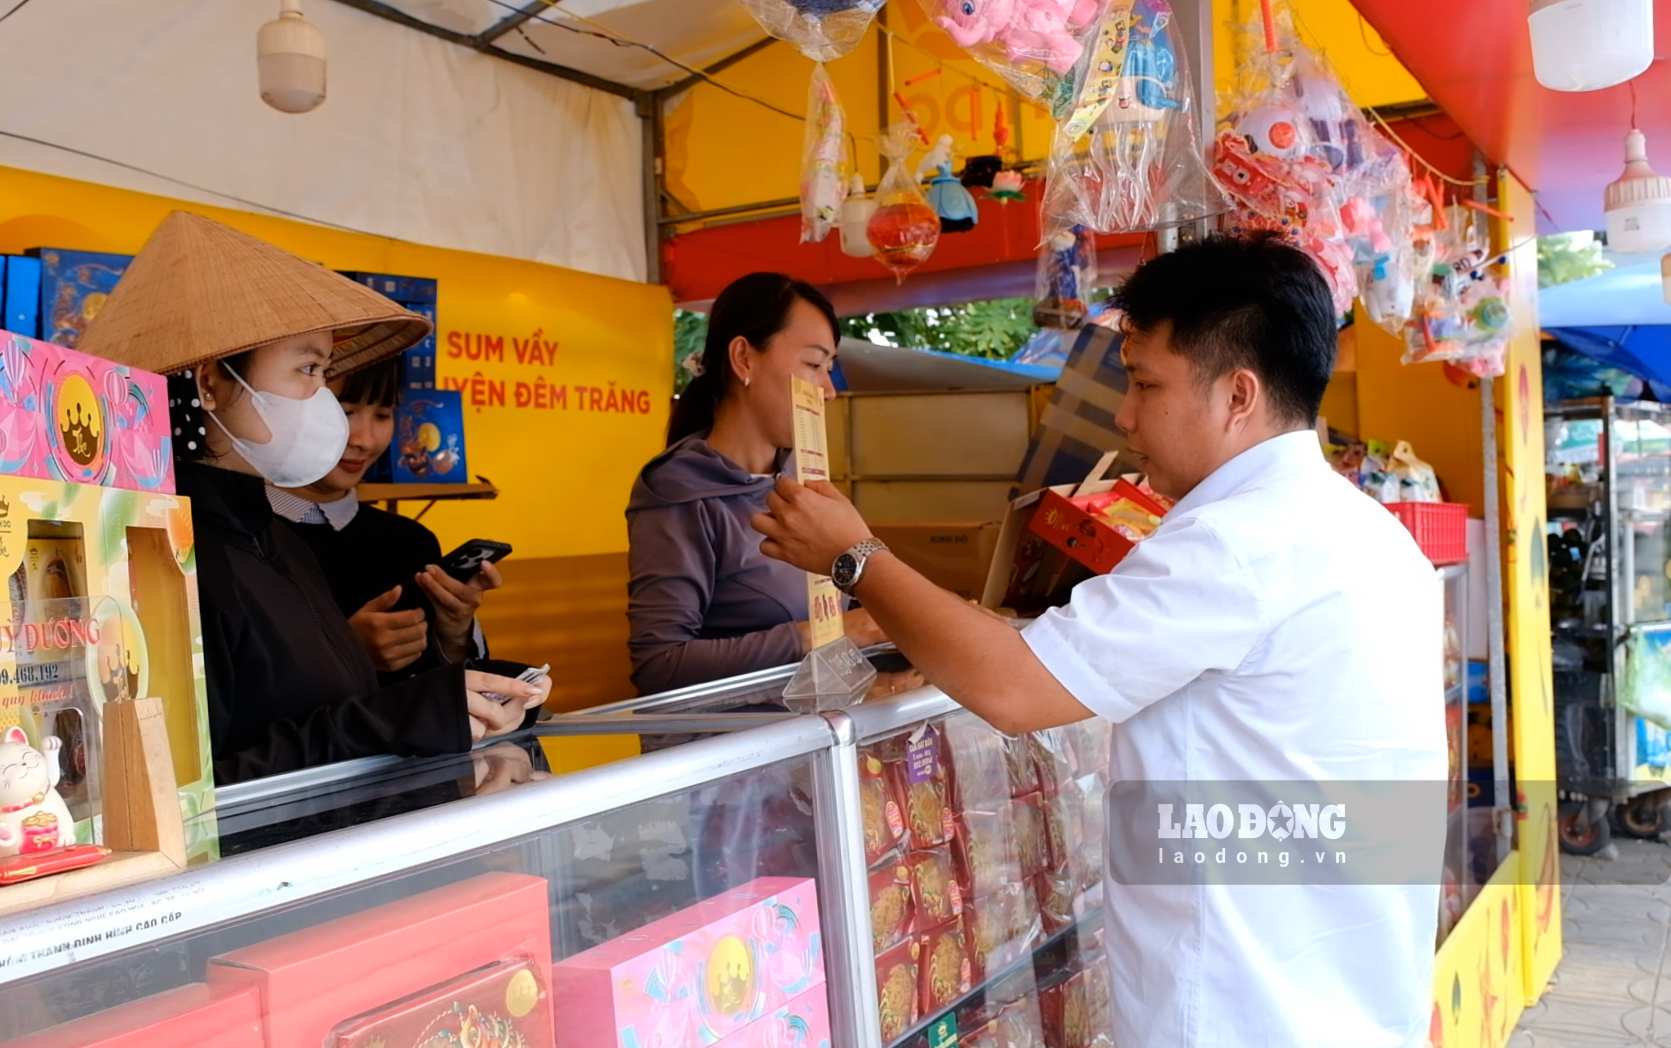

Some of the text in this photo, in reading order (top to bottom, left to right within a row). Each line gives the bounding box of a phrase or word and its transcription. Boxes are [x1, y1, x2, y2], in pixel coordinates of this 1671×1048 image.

[446, 330, 505, 363] SUM
[443, 370, 652, 414] YỆN ĐÊM TRĂNG
[0, 663, 59, 686] 9.468.192
